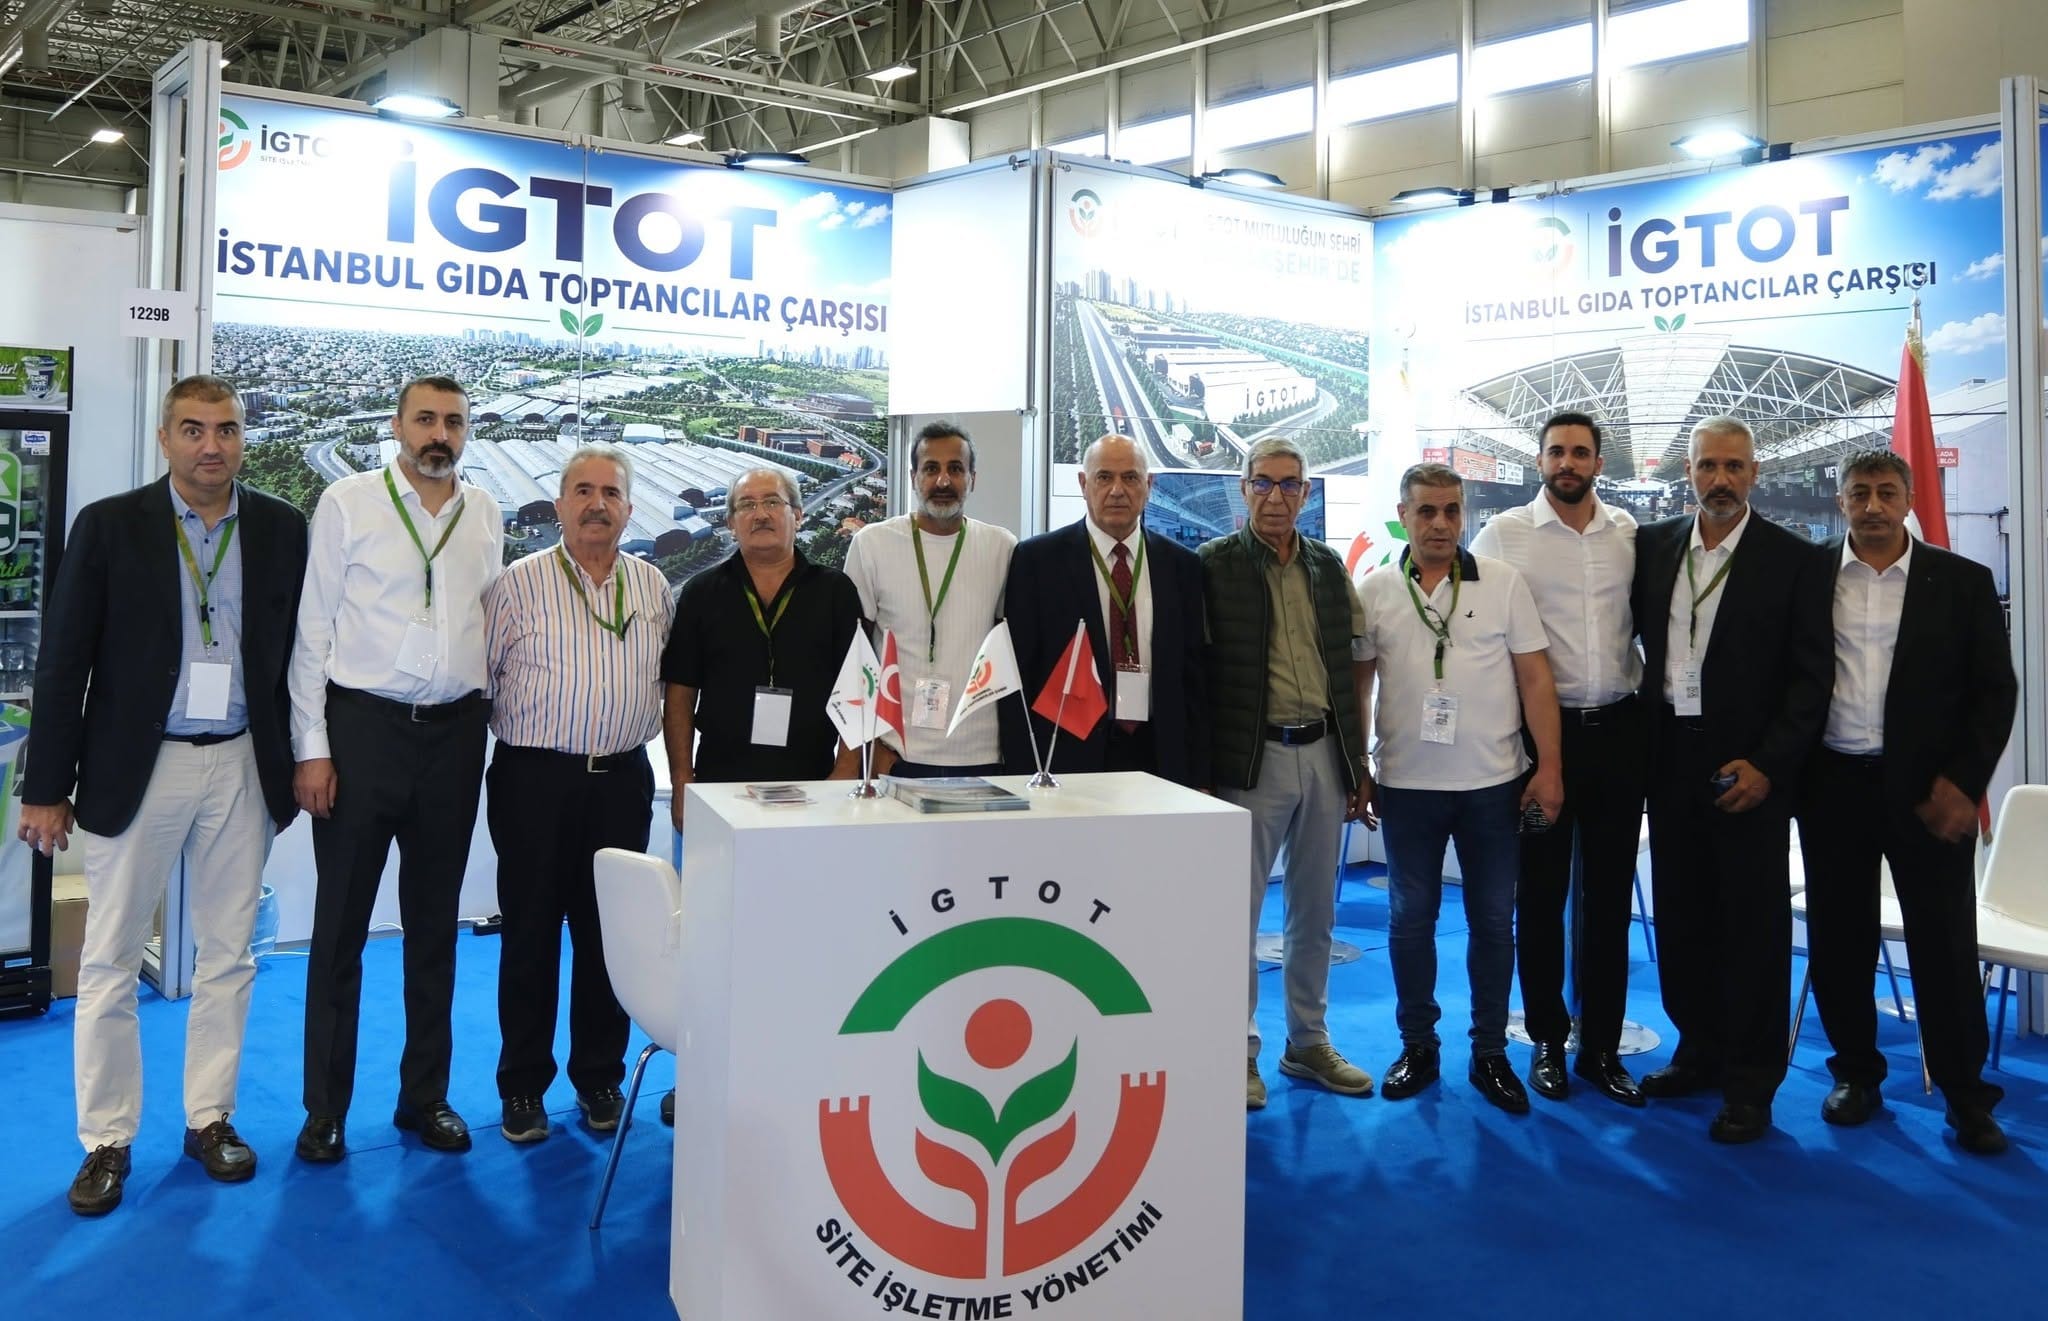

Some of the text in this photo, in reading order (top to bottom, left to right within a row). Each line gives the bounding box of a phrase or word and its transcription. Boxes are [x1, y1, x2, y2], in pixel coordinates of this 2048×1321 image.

[260, 124, 330, 158] İGTO
[387, 138, 778, 281] İGTOT
[1607, 196, 1849, 277] İGTOT
[129, 306, 170, 321] 1229B
[217, 228, 888, 337] İSTANBUL GIDA TOPTANCILAR ÇARŞISI
[1464, 261, 1936, 325] İSTANBUL GIDA TOPTANCILAR ÇARŞISI
[1246, 385, 1297, 410] İGTOT
[888, 875, 1111, 936] İGTOT
[815, 1199, 1164, 1321] SİTE İŞLETME YÖNETİMİ
